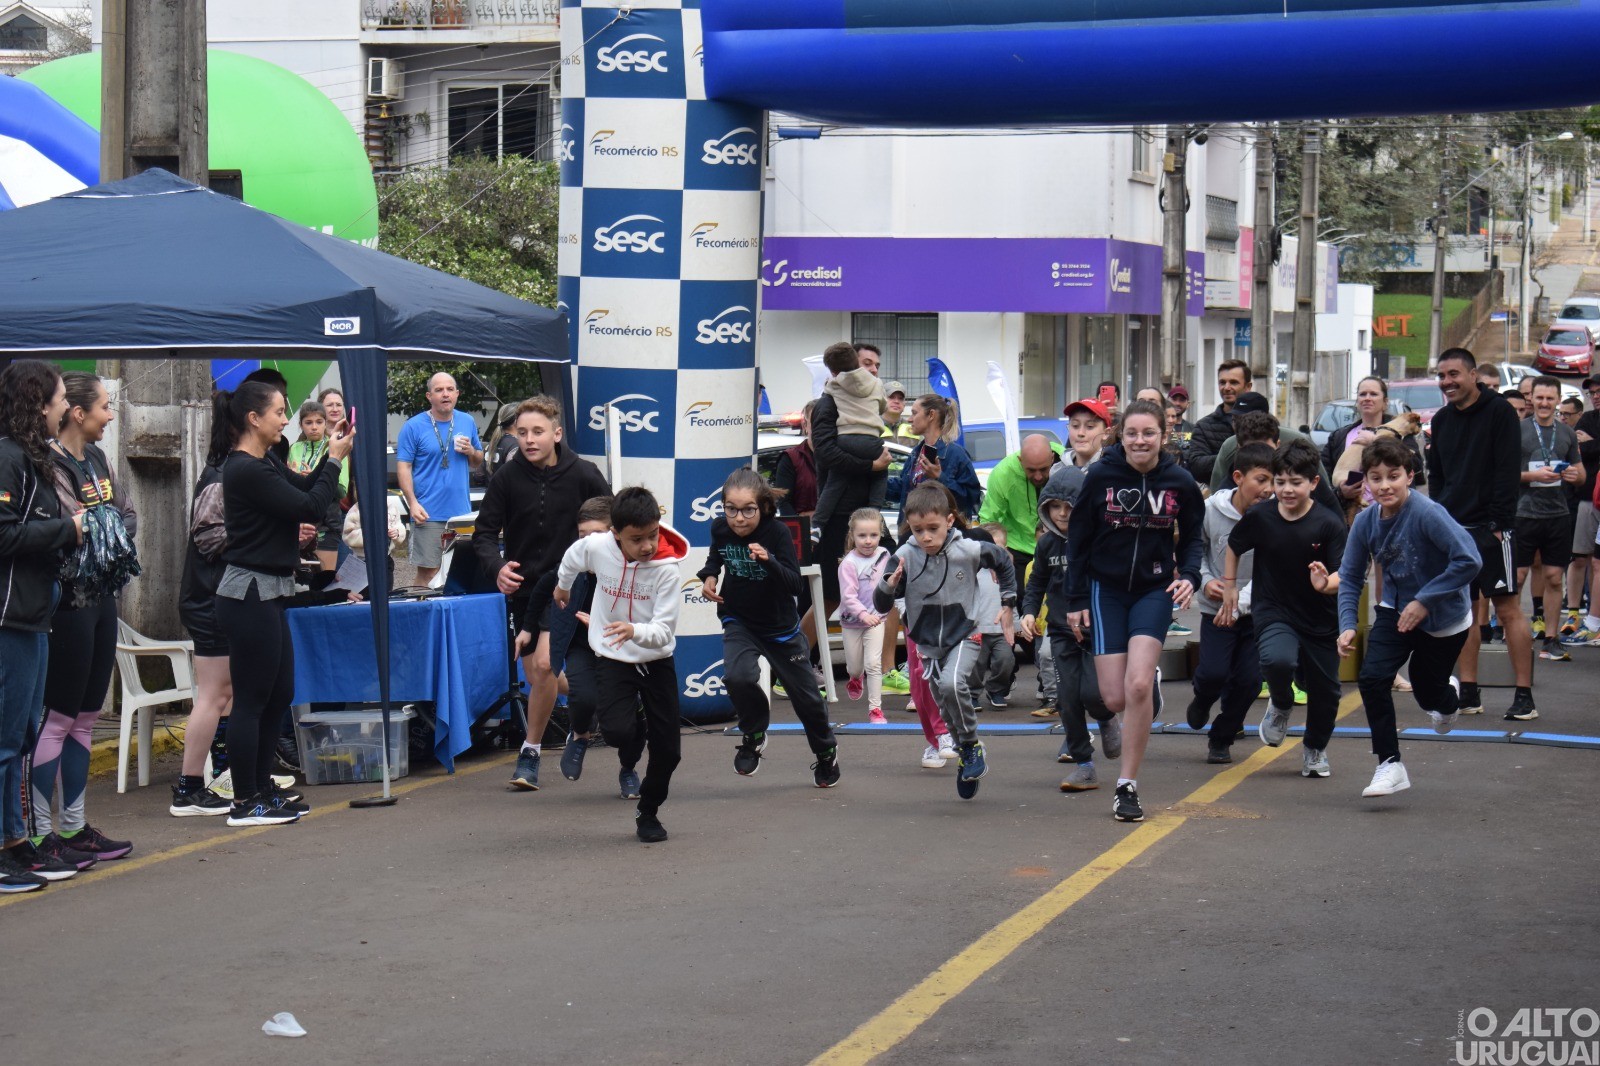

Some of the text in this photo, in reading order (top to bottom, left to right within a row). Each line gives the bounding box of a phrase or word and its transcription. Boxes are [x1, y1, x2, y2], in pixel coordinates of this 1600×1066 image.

[597, 47, 668, 72] Sesc
[594, 145, 679, 157] Fecomércio RS
[701, 139, 758, 165] Sesc
[593, 227, 665, 253] Sesc
[696, 237, 749, 248] Fecomércio
[791, 266, 842, 279] credisol
[331, 322, 352, 330] MOR
[589, 324, 673, 337] Fecomércio RS
[695, 319, 752, 344] Sesc
[690, 416, 744, 426] Fecomércio
